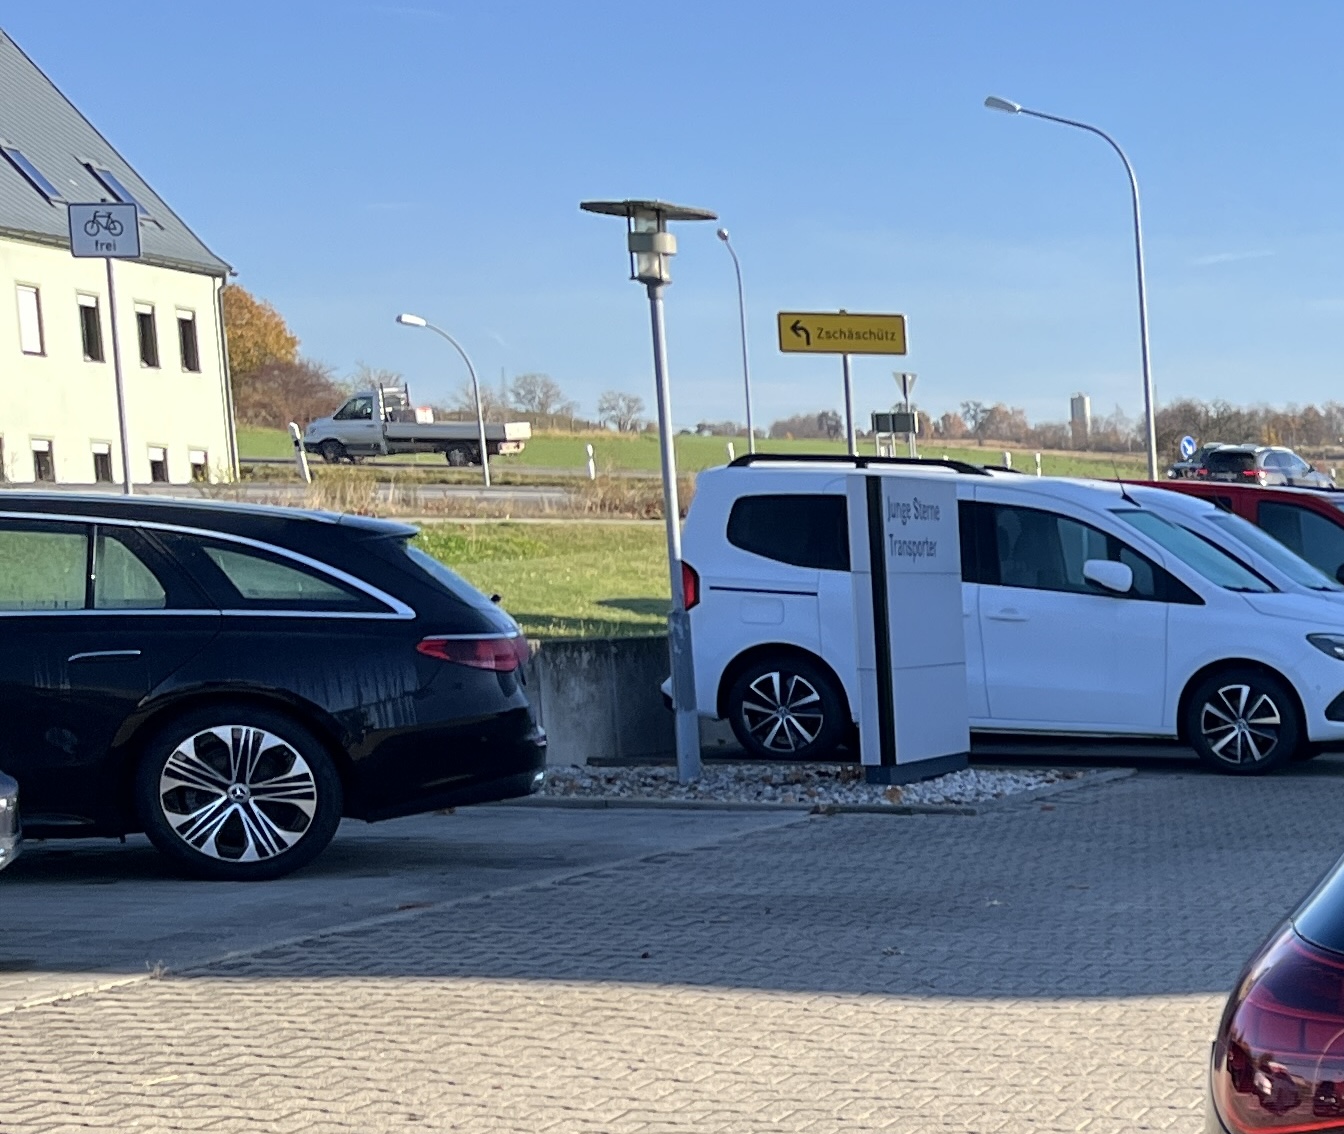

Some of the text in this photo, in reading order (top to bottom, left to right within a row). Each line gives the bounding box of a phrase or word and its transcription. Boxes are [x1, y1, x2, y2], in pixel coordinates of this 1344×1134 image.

[95, 240, 117, 252] frei
[816, 327, 897, 341] Zschäschütz
[887, 495, 941, 526] Junge Sterne
[888, 533, 937, 564] Transporter
